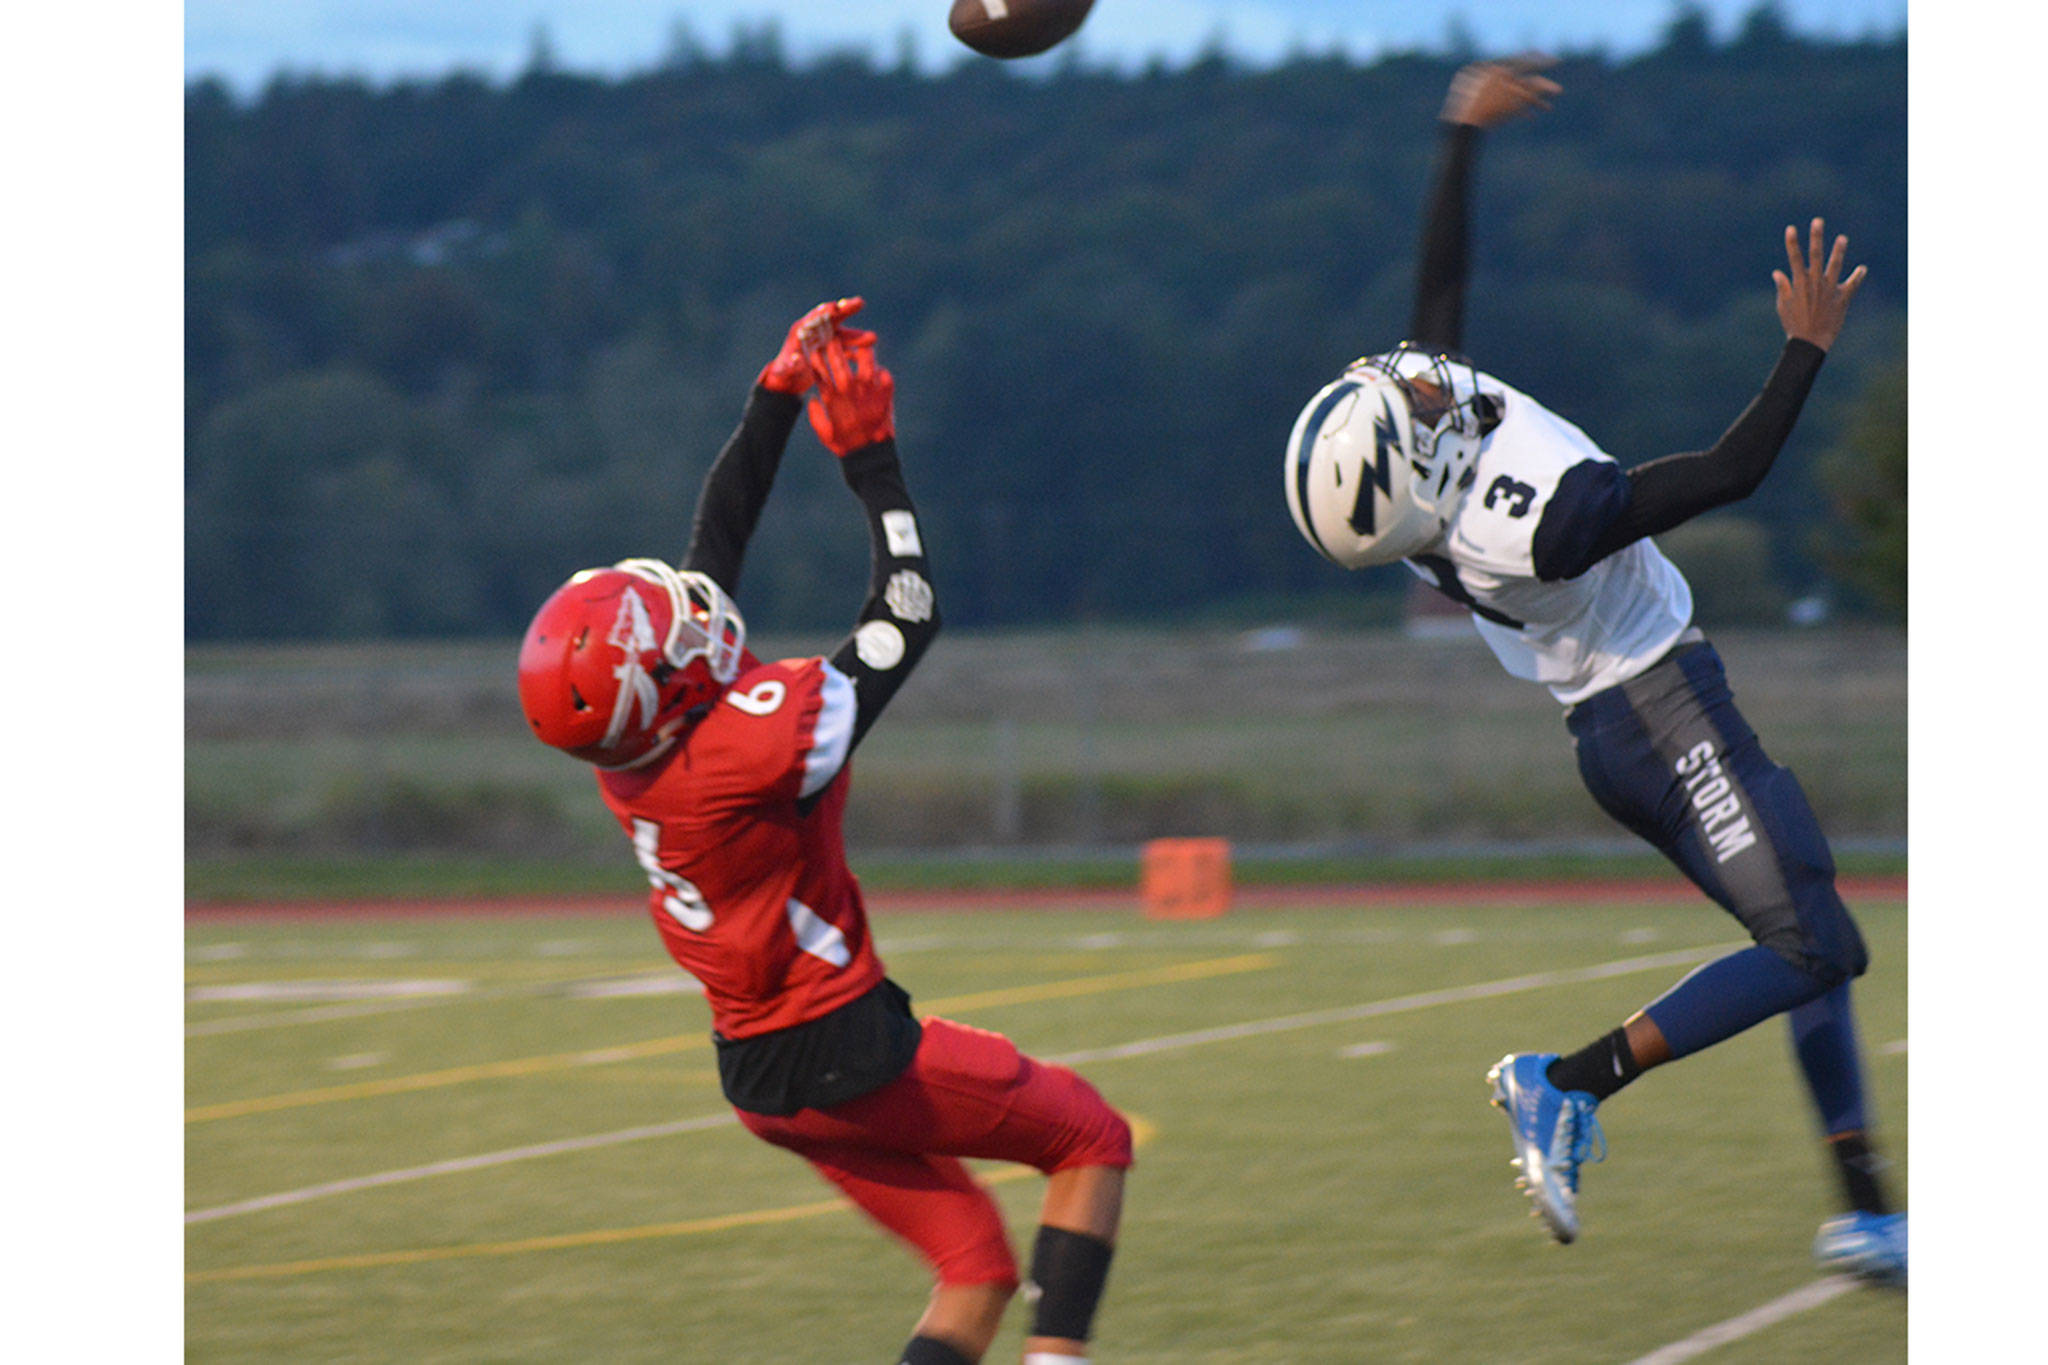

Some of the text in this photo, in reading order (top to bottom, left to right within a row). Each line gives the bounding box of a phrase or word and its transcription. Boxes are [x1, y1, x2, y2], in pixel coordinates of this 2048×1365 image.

[1483, 474, 1537, 519] 3
[726, 680, 787, 716] 6
[1675, 740, 1757, 864] STORM
